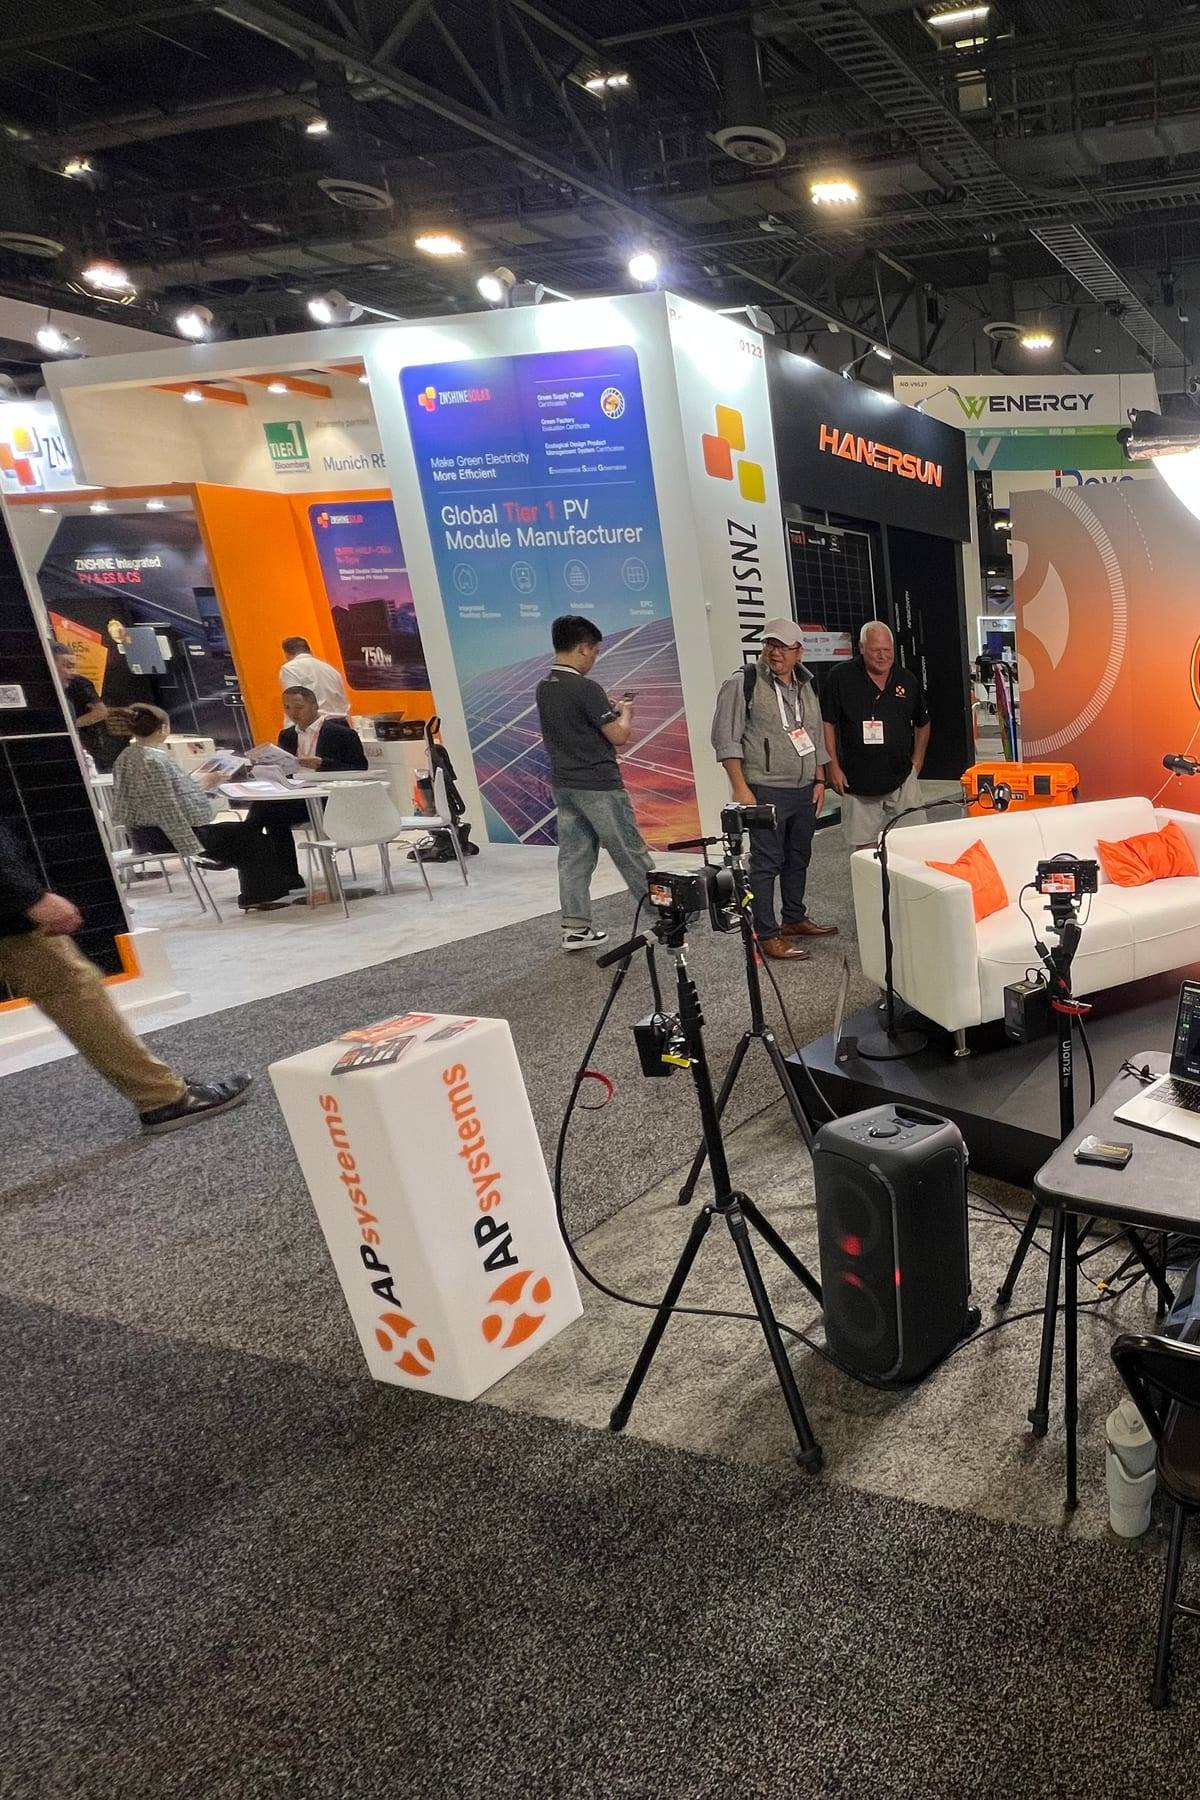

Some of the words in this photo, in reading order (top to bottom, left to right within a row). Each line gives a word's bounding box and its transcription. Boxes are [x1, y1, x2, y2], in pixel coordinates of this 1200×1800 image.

[269, 442, 295, 459] TIER
[323, 455, 369, 472] Munich
[431, 456, 454, 469] Make
[456, 454, 484, 467] Green
[486, 452, 530, 467] Electricity
[819, 423, 943, 488] HANERSUN
[433, 470, 458, 482] More
[459, 467, 497, 480] Efficient
[441, 504, 499, 526] Global
[504, 502, 539, 522] Tier
[545, 501, 556, 520] 1
[563, 499, 590, 520] PV
[445, 529, 512, 551] Module
[517, 525, 643, 548] Manufacturer
[442, 1063, 519, 1273] APsystems
[319, 1094, 402, 1309] APsystems
